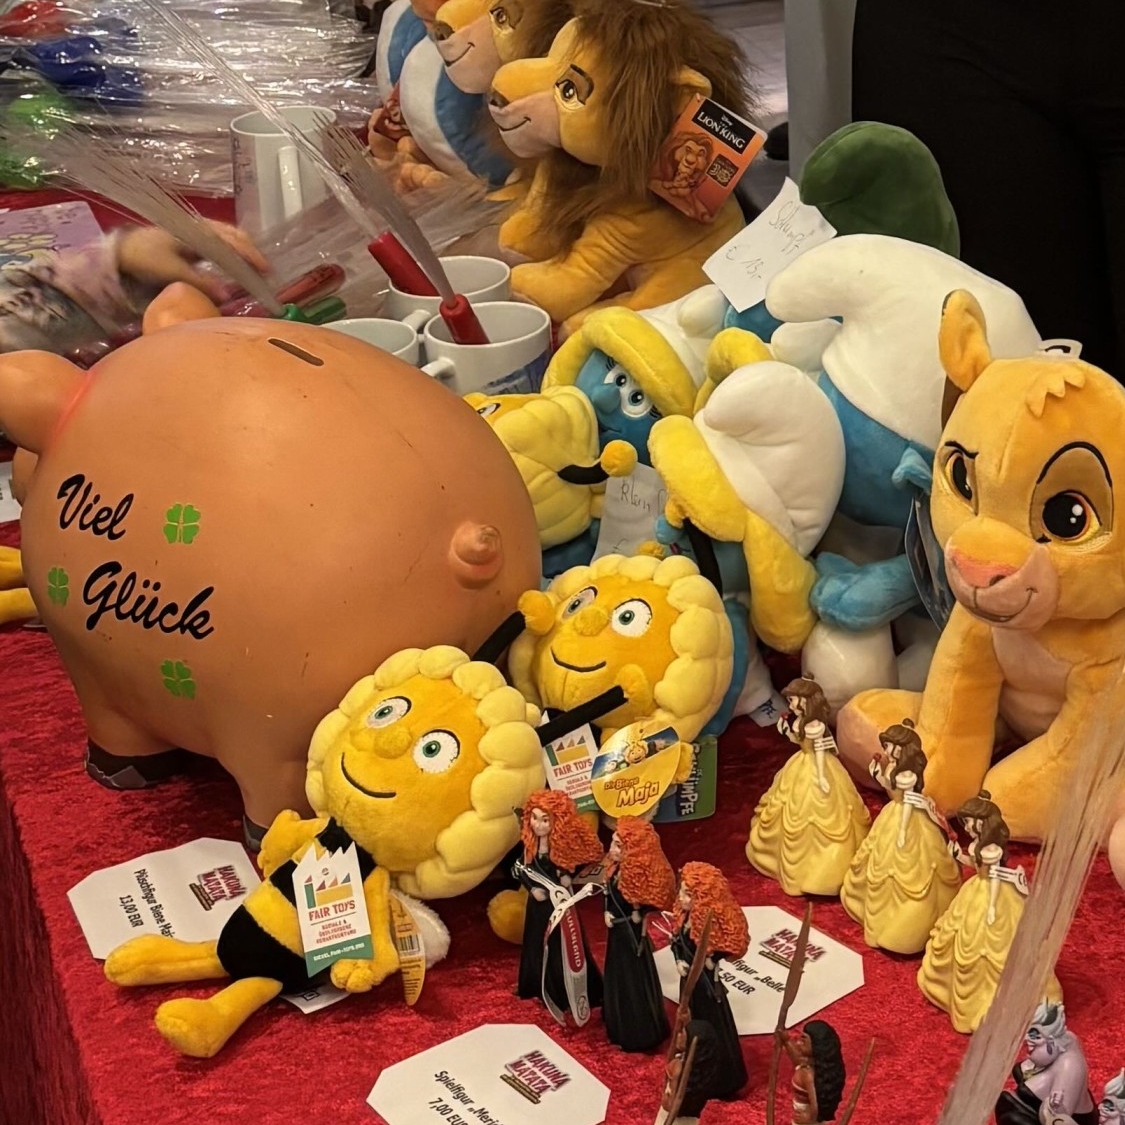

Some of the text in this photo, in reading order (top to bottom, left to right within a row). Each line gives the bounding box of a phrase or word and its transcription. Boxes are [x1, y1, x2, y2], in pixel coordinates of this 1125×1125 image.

[697, 111, 746, 149] LION KING
[57, 473, 134, 541] Viel
[83, 561, 214, 640] Glück
[553, 758, 593, 778] FAIR TOYS
[616, 776, 640, 790] Biene
[616, 781, 660, 807] Maja
[201, 871, 226, 902] MATATA
[119, 894, 144, 928] 13,00 EUR
[150, 904, 165, 924] Biene
[308, 900, 356, 922] FAIR TOYS
[732, 979, 756, 995] EUR
[509, 1060, 552, 1094] MATATA
[524, 1049, 571, 1087] HAKUNA
[434, 1070, 475, 1106] Spielfigur
[428, 1097, 454, 1116] 7,00
